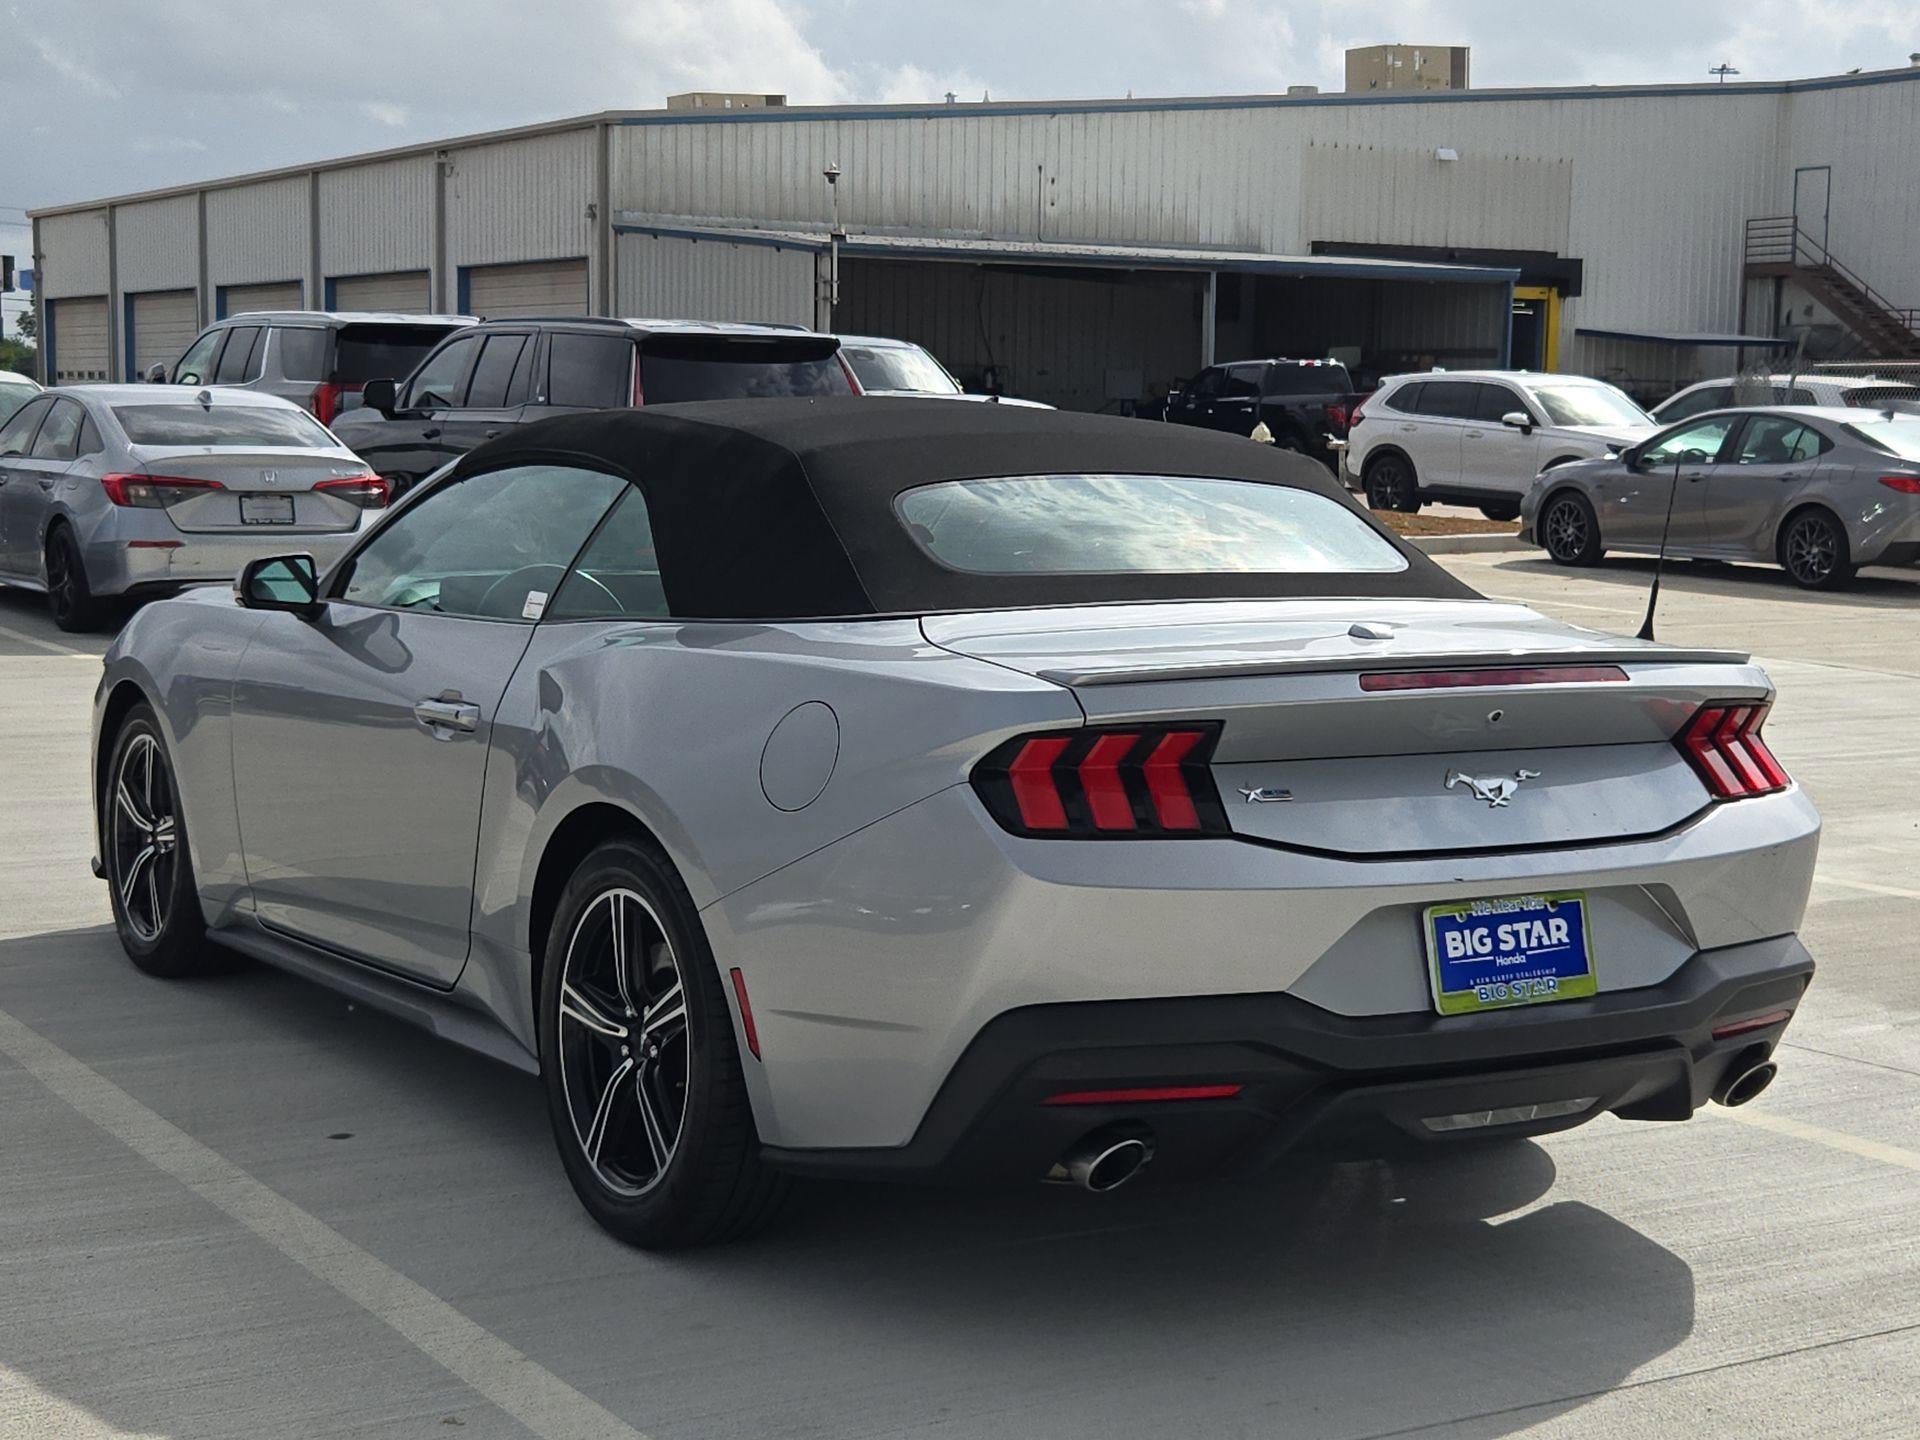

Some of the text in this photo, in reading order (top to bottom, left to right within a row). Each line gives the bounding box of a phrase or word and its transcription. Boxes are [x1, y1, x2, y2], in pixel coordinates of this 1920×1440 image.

[1471, 895, 1545, 916] We Hear You
[1445, 918, 1570, 958] BIG STAR
[1495, 953, 1526, 967] Honda
[1515, 967, 1557, 979] DEALERSHIP
[1477, 978, 1557, 1002] BIG STAR
